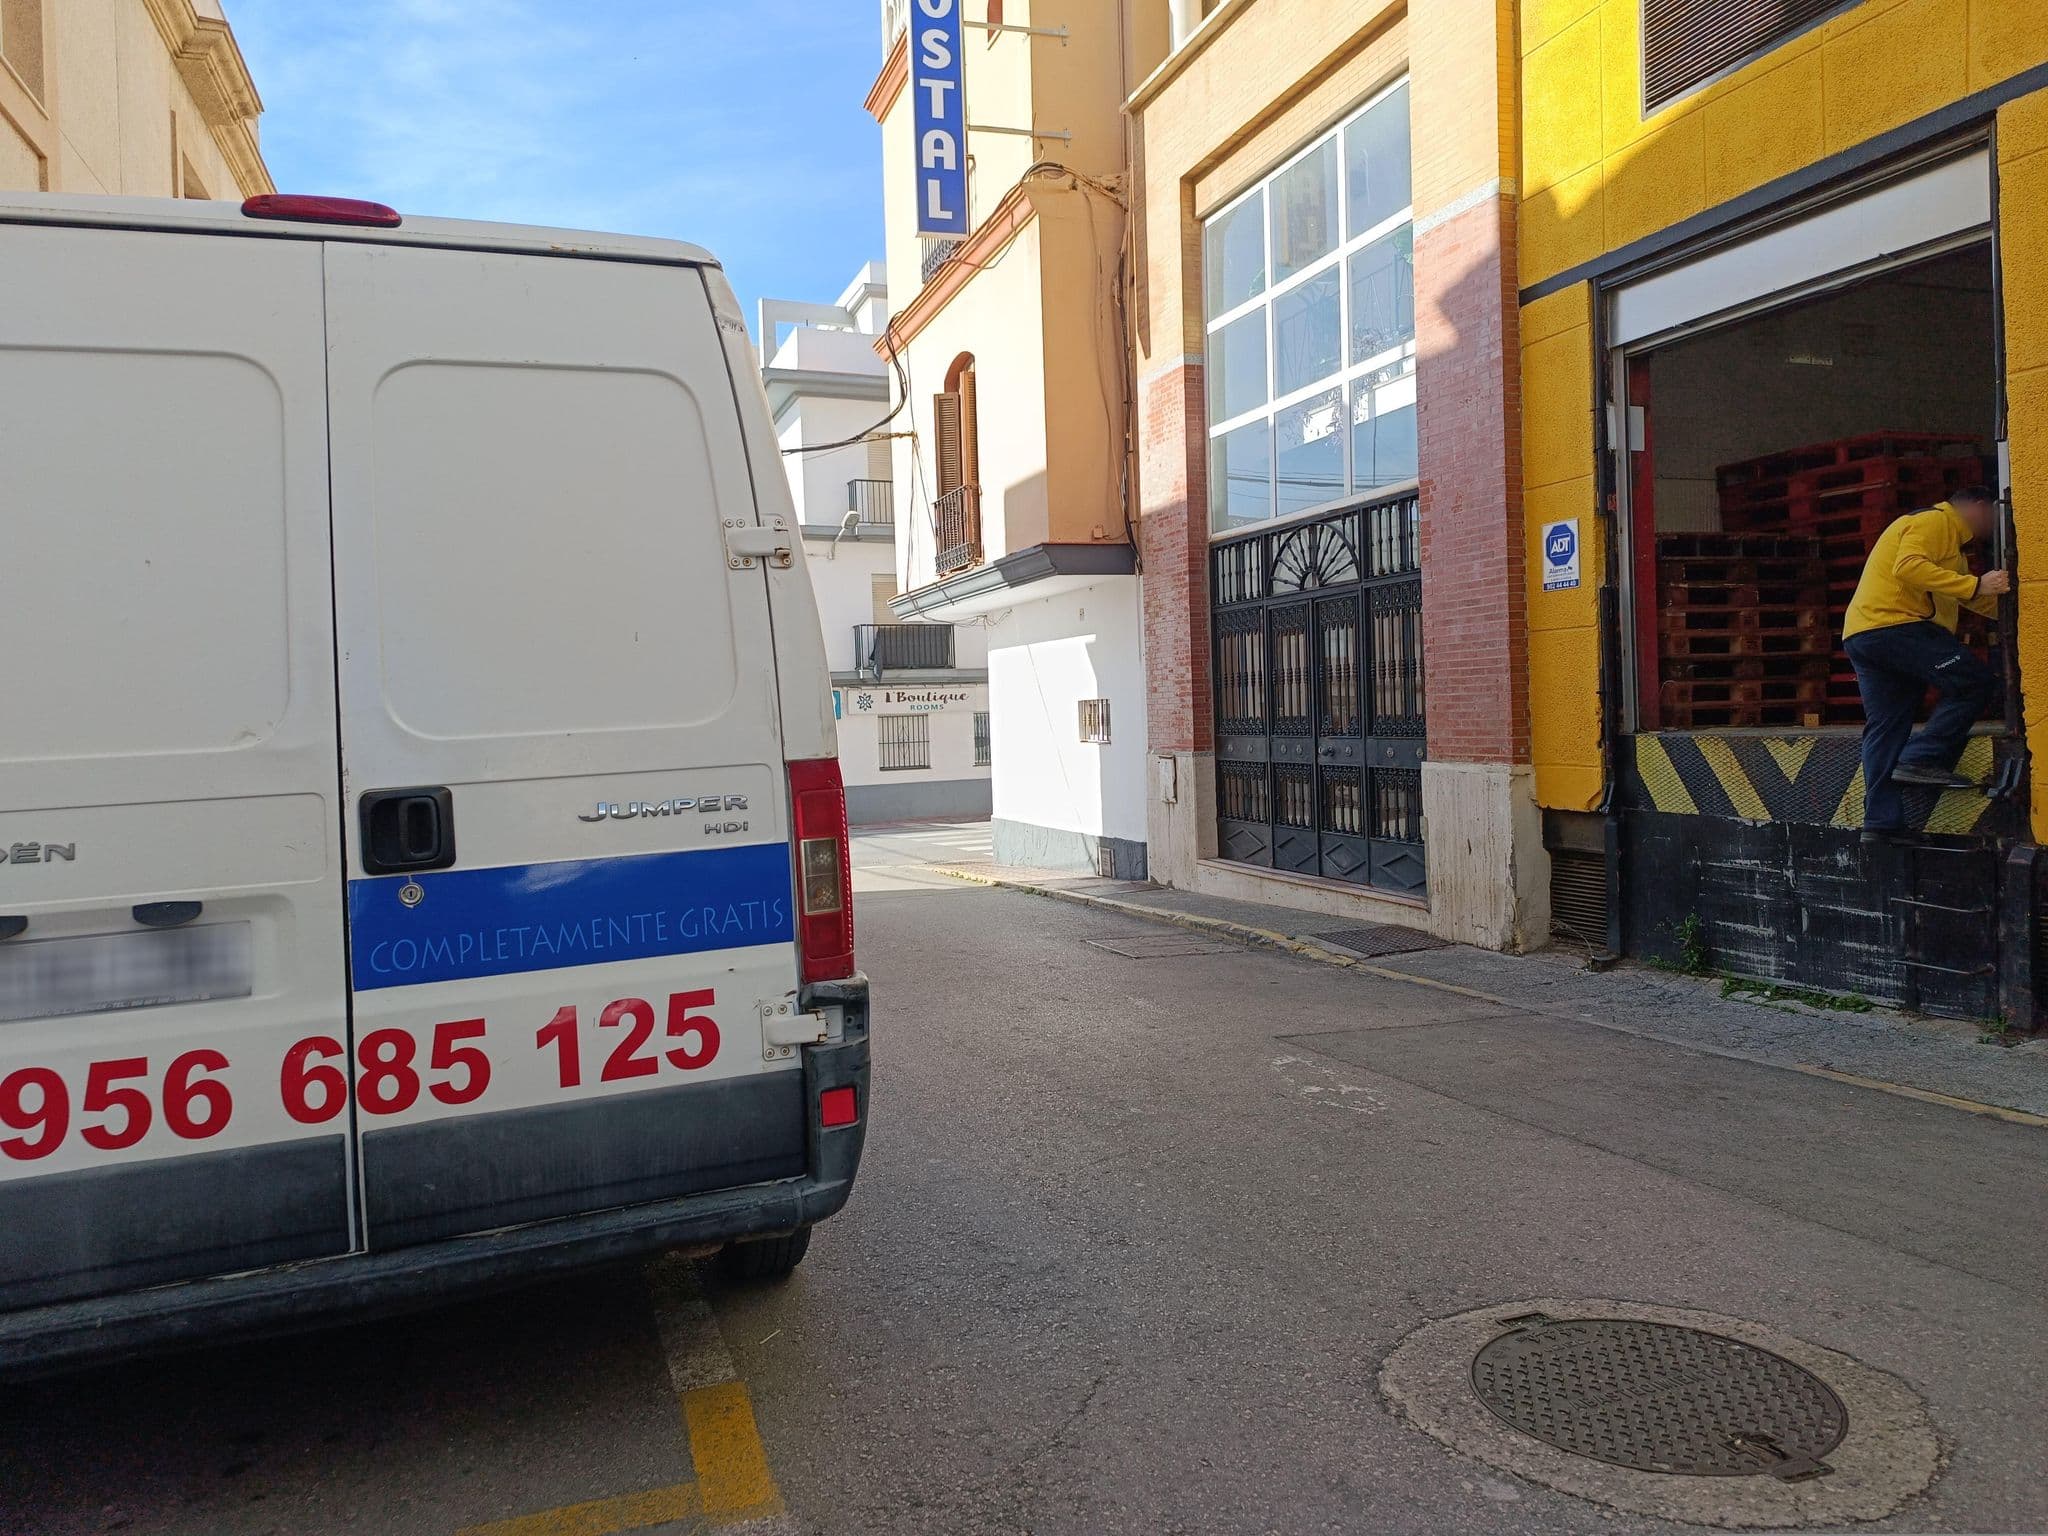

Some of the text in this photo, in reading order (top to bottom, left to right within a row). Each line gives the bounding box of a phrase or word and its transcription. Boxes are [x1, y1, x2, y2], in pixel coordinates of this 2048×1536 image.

[1551, 538, 1570, 553] ADT
[578, 794, 748, 822] JUMPER
[704, 821, 748, 834] HDI
[0, 841, 76, 864] ËN
[370, 898, 784, 973] COMPLETAMENTE GRATIS
[0, 988, 721, 1160] 956 685 125
